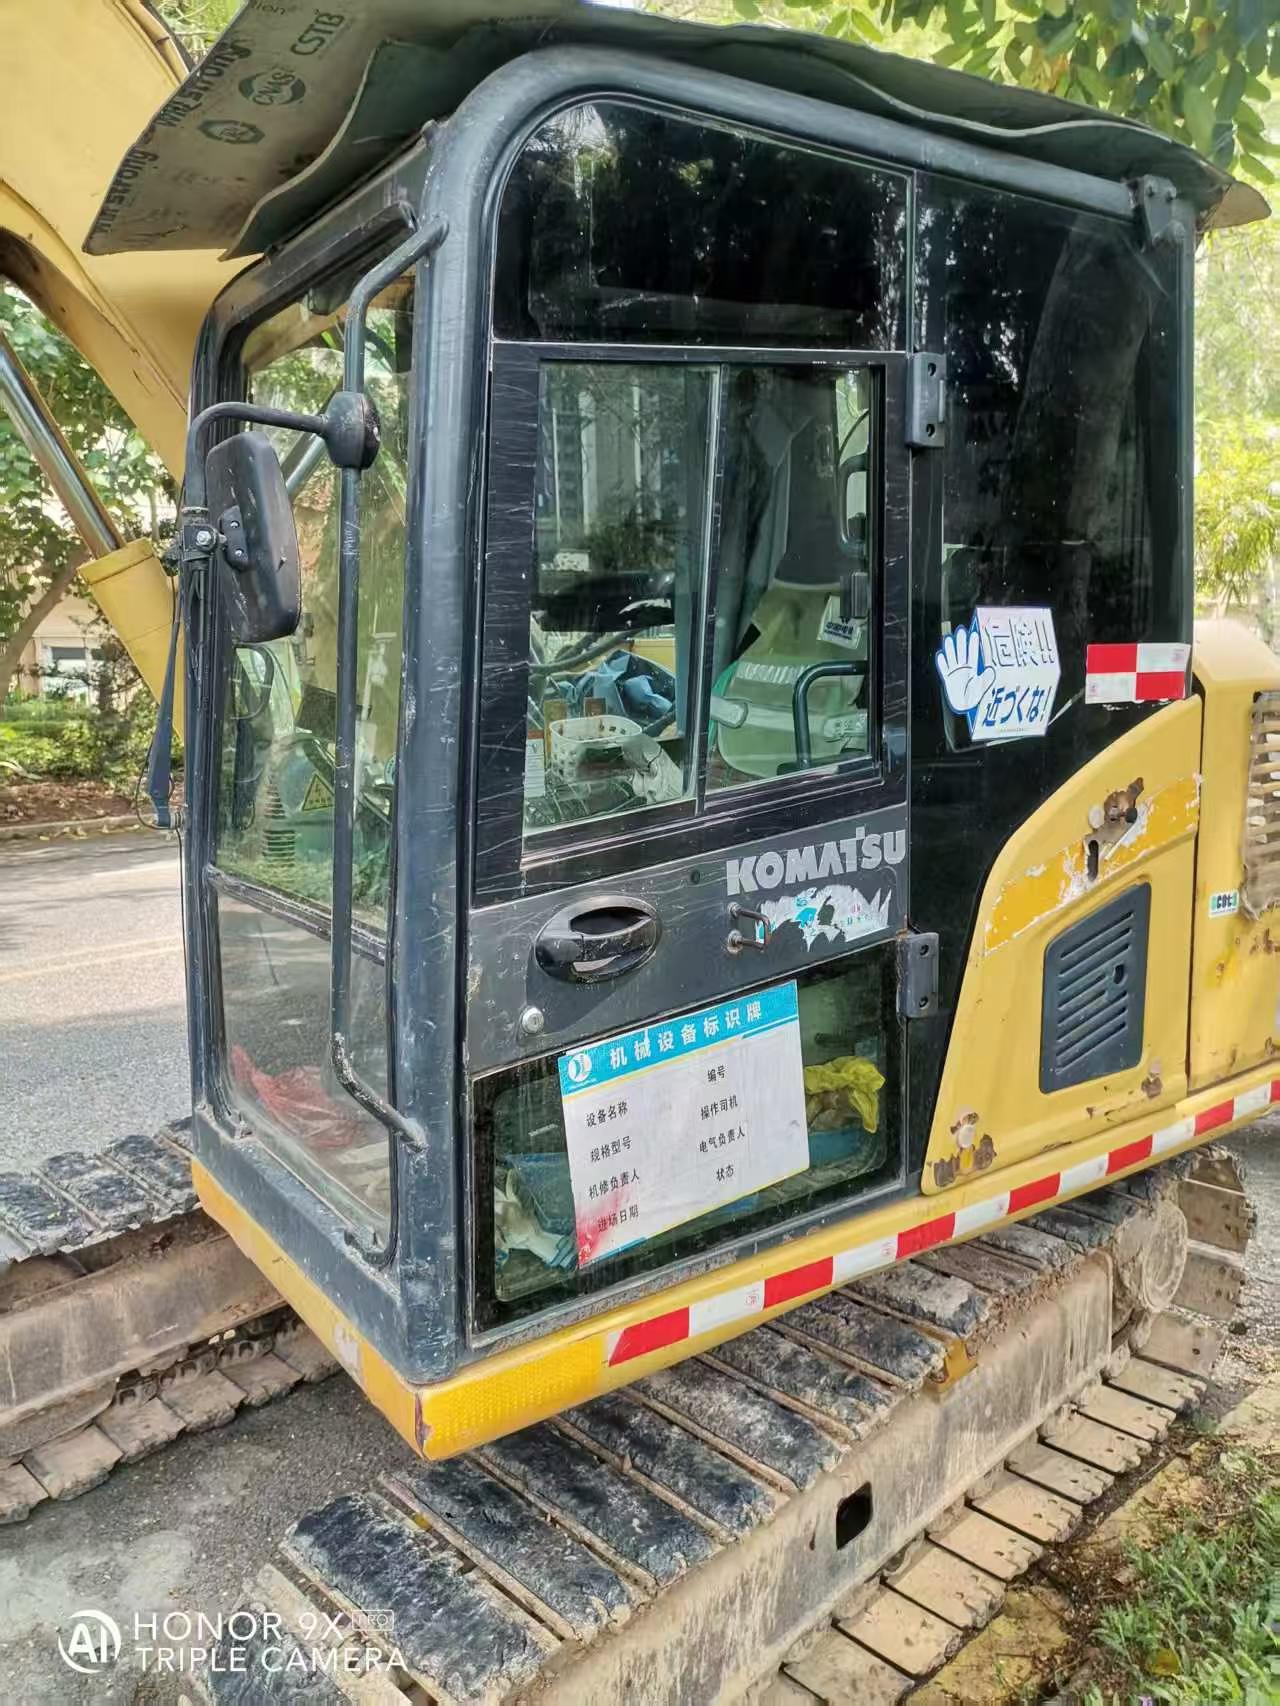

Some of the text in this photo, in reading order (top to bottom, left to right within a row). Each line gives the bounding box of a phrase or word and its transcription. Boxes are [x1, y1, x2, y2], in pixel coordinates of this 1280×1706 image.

[290, 12, 345, 56] CSTB
[252, 70, 296, 106] CNAS
[726, 825, 907, 896] KOMATSU
[609, 1001, 762, 1070] 机械设备标识牌
[707, 1064, 727, 1083] 编号
[586, 1101, 629, 1128] 设备名称
[700, 1095, 739, 1121] 操作司机
[590, 1136, 632, 1163] 规格型号
[699, 1126, 746, 1154] 电气负责人
[588, 1168, 640, 1200] 机修负责人
[716, 1164, 735, 1181] 状态
[597, 1205, 640, 1233] 进场日期
